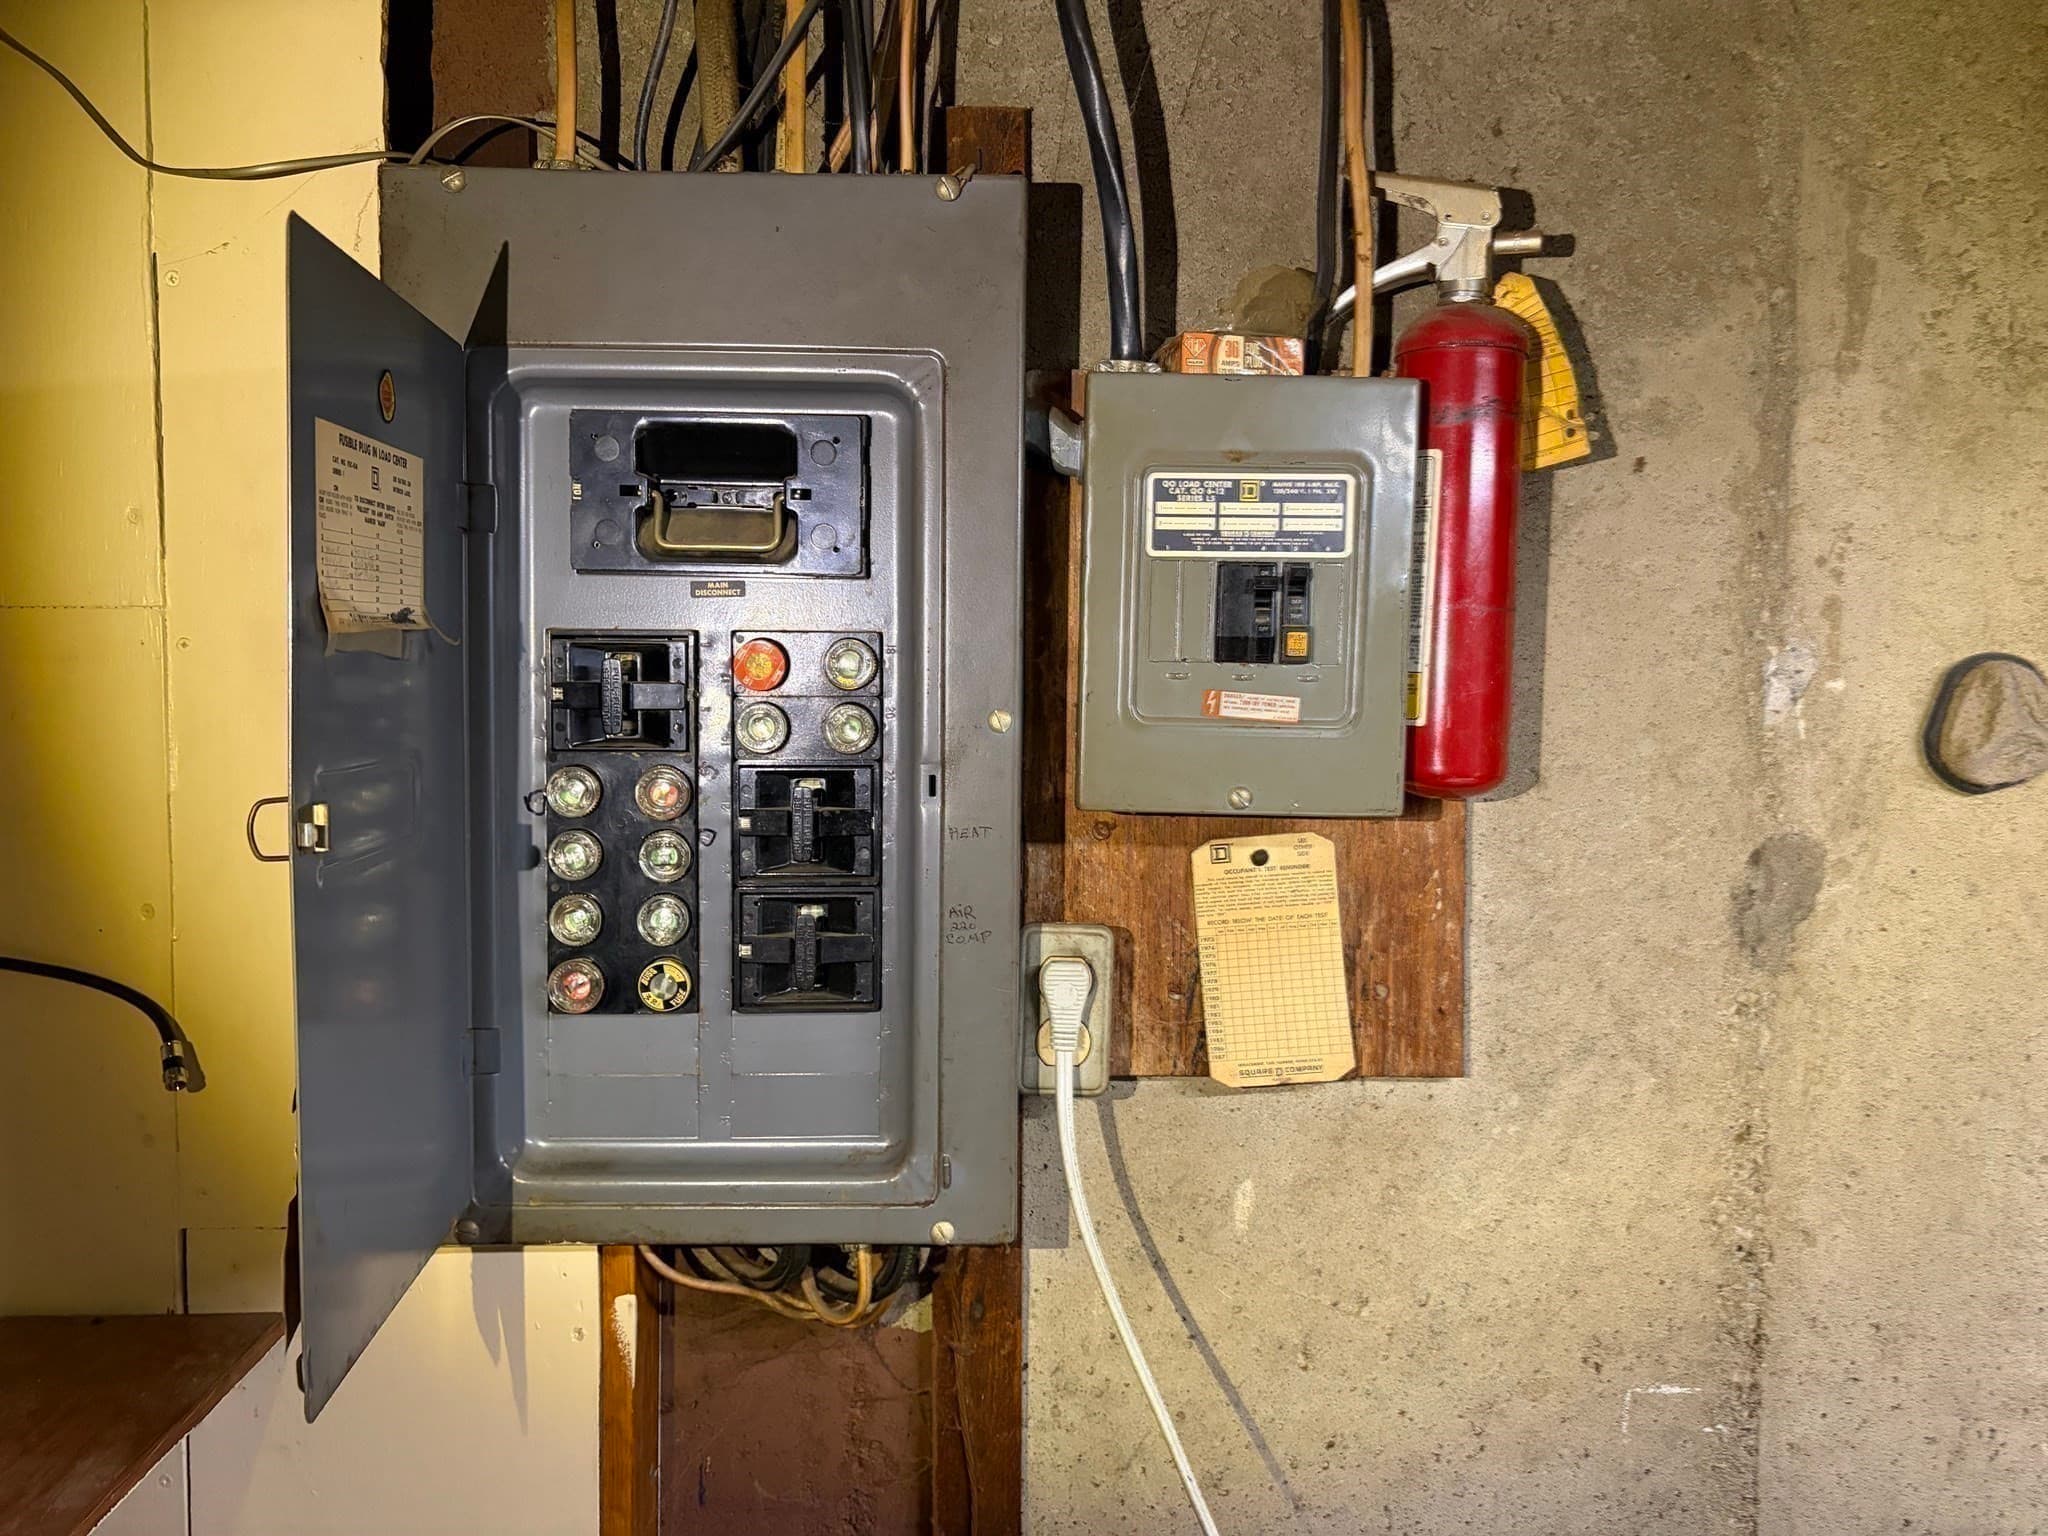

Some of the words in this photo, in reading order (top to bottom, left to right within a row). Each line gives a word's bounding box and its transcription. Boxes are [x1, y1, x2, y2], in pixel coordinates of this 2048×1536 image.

[1225, 340, 1239, 358] 30
[339, 433, 357, 450] FUSIBLE
[359, 441, 371, 457] PLUG
[372, 447, 378, 459] IN
[379, 448, 392, 463] LOAD
[393, 454, 408, 469] CENTER
[1203, 481, 1233, 489] CENTER
[887, 645, 897, 656] 18
[886, 707, 897, 720] 20
[949, 826, 993, 840] HEAT
[951, 921, 977, 932] 220
[946, 930, 993, 945] COMP
[641, 967, 658, 986] BUSS
[670, 988, 686, 1007] FUSE
[1239, 1068, 1273, 1076] SQUARE
[1285, 1064, 1324, 1073] COMPANY
